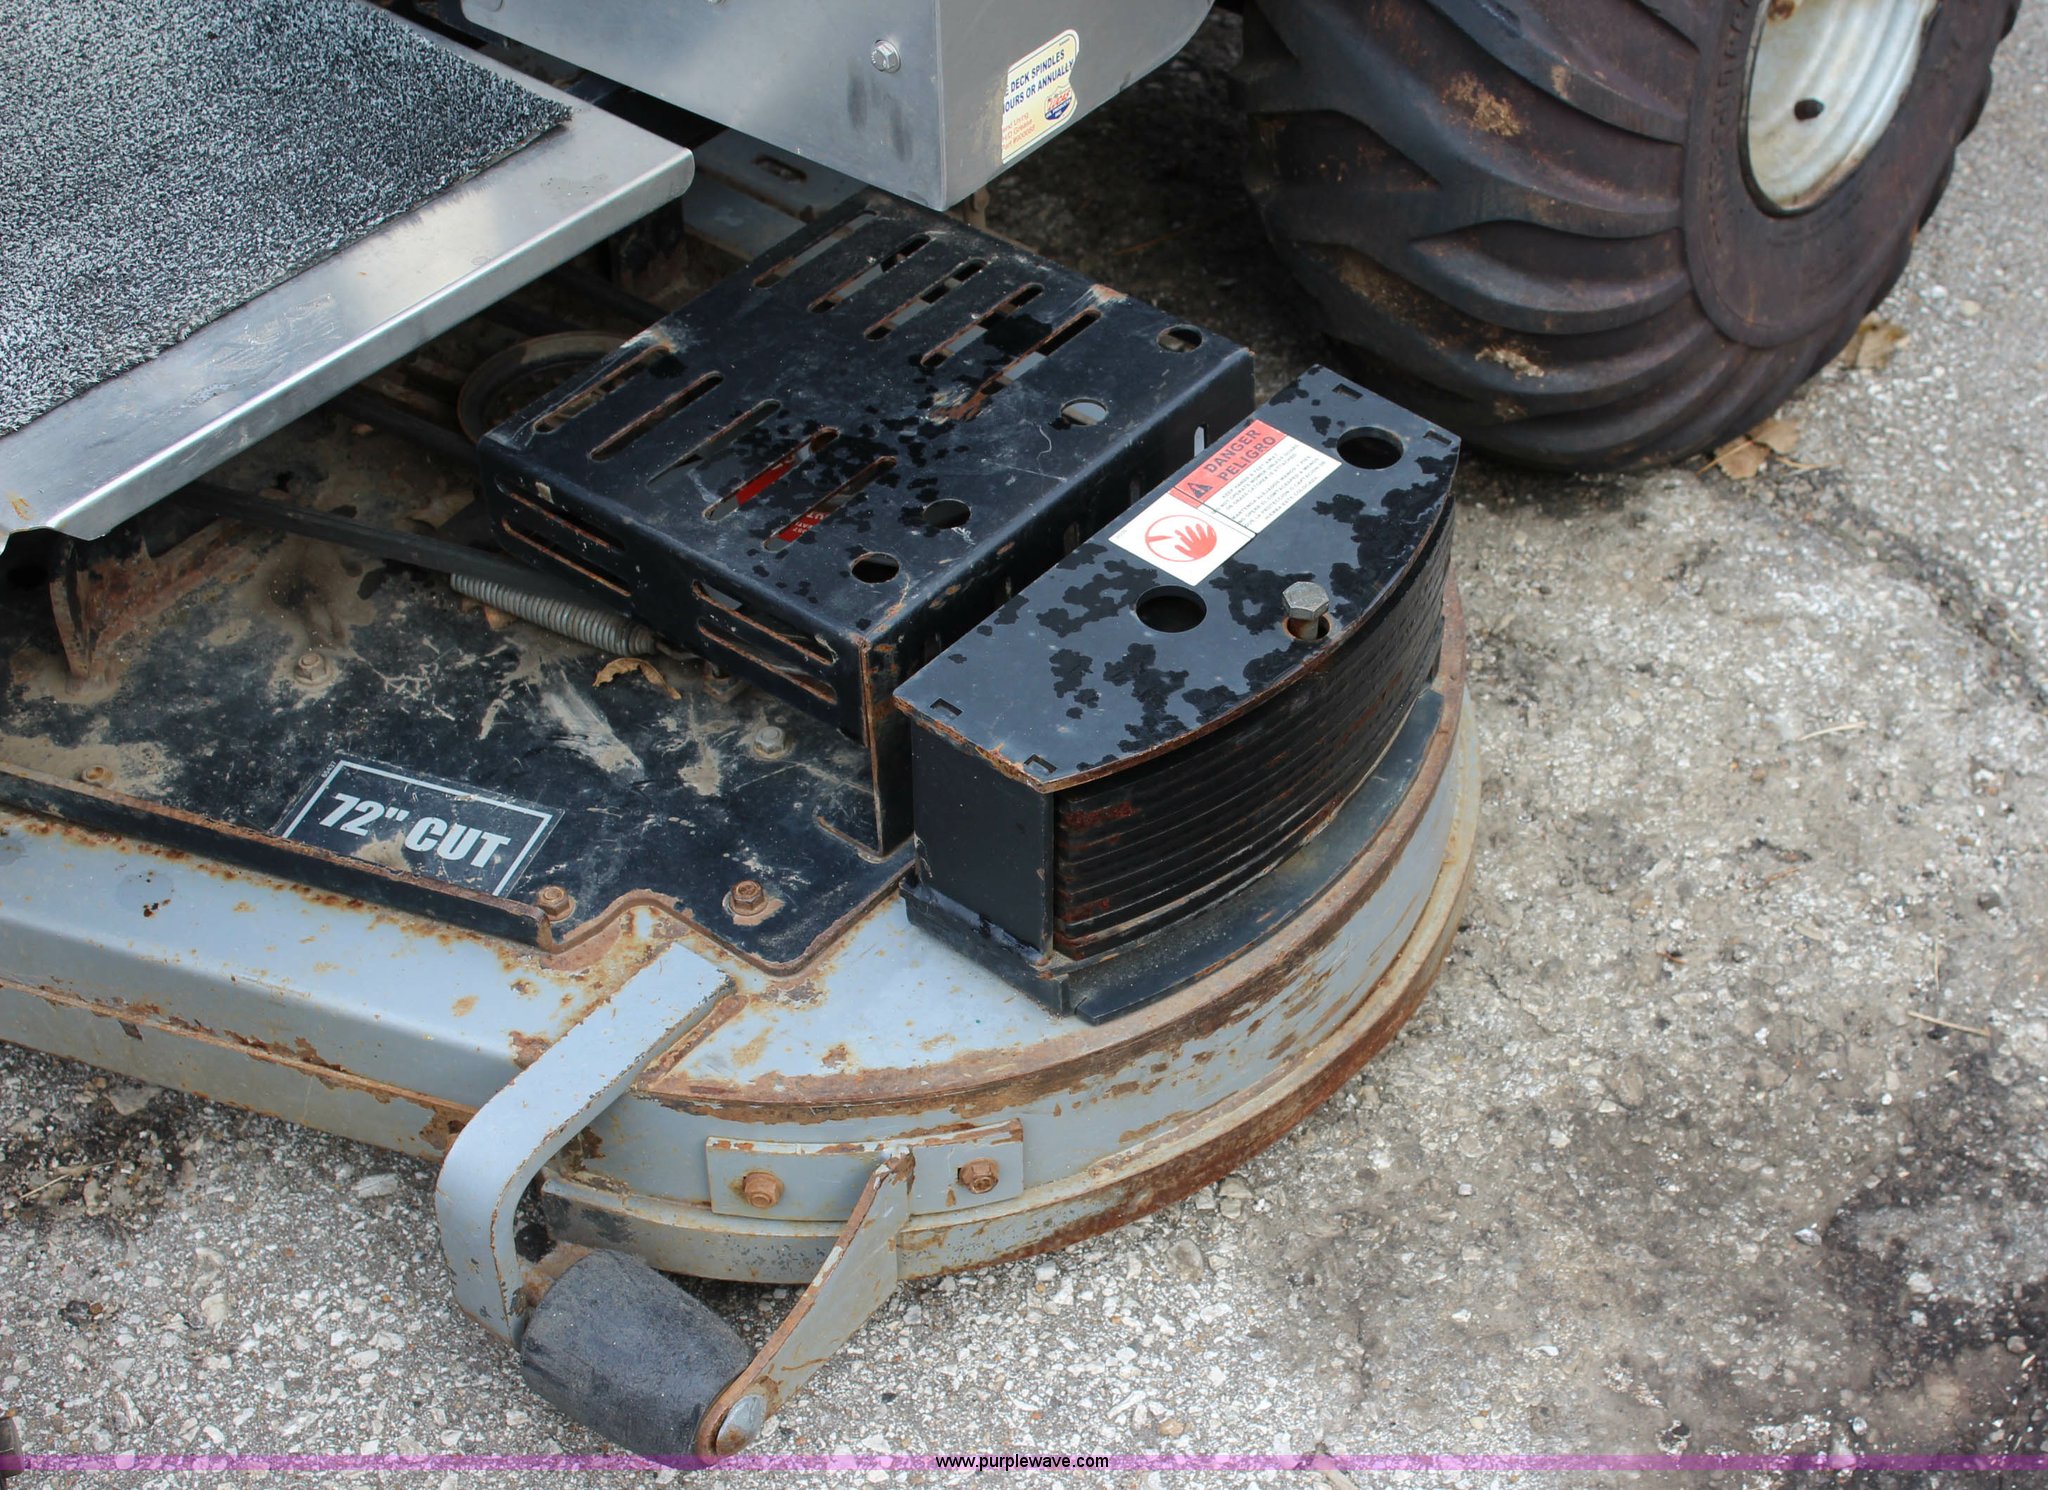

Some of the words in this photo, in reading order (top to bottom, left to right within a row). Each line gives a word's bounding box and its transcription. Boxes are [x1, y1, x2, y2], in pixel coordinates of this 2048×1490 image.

[1011, 72, 1029, 92] DECK
[1031, 49, 1065, 78] SPINDLES
[1026, 84, 1036, 98] OR
[1038, 58, 1073, 91] ANNUALLY
[1204, 429, 1261, 473] DANGER
[1218, 436, 1276, 481] PELIGRO
[319, 792, 410, 836] 72"
[404, 816, 512, 868] CUT
